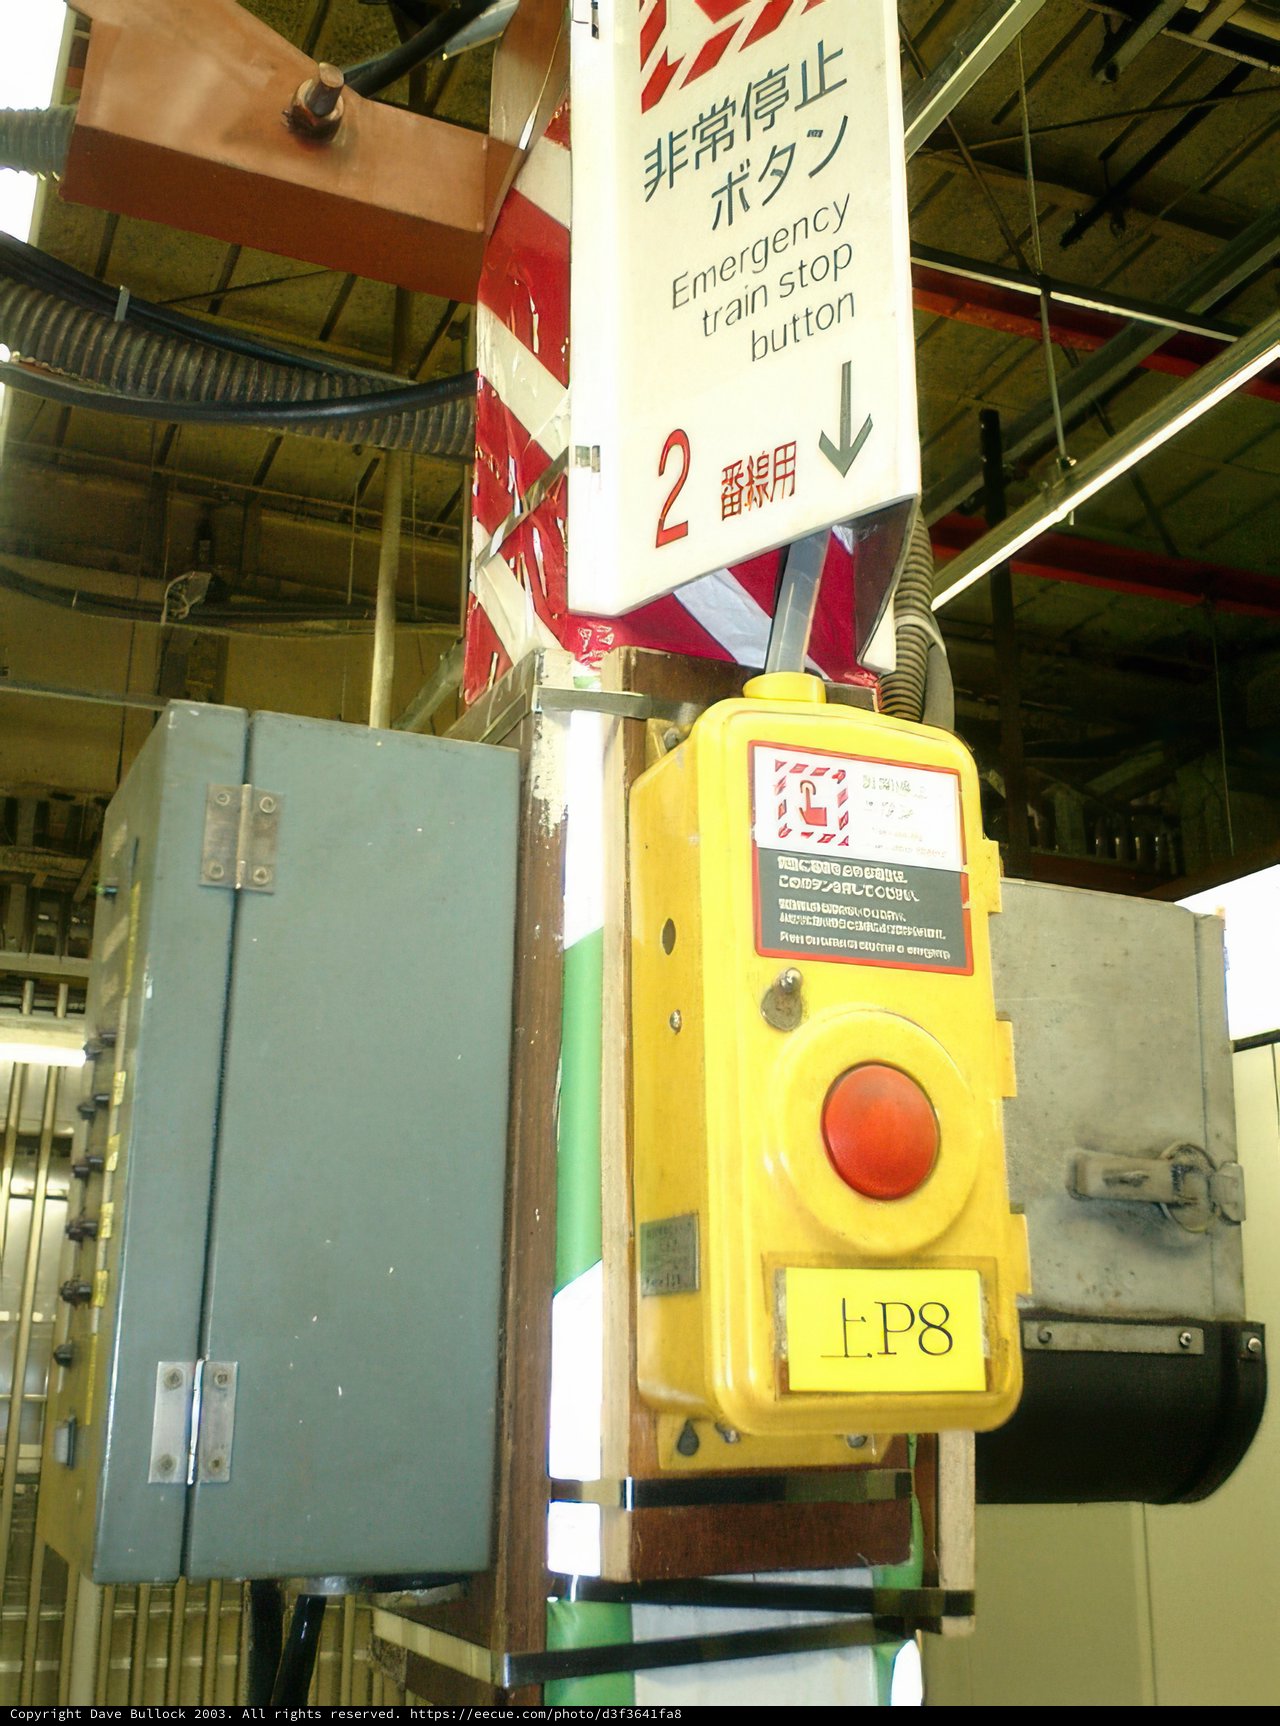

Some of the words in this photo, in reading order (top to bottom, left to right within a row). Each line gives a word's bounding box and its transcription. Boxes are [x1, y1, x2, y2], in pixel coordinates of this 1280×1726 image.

[644, 39, 848, 203] 非常停止
[711, 115, 849, 231] ボタン
[672, 193, 850, 310] Emergency
[702, 284, 768, 337] train
[779, 243, 853, 299] stop
[751, 292, 855, 362] button
[655, 428, 691, 548] 2
[821, 1298, 953, 1358] 上P8
